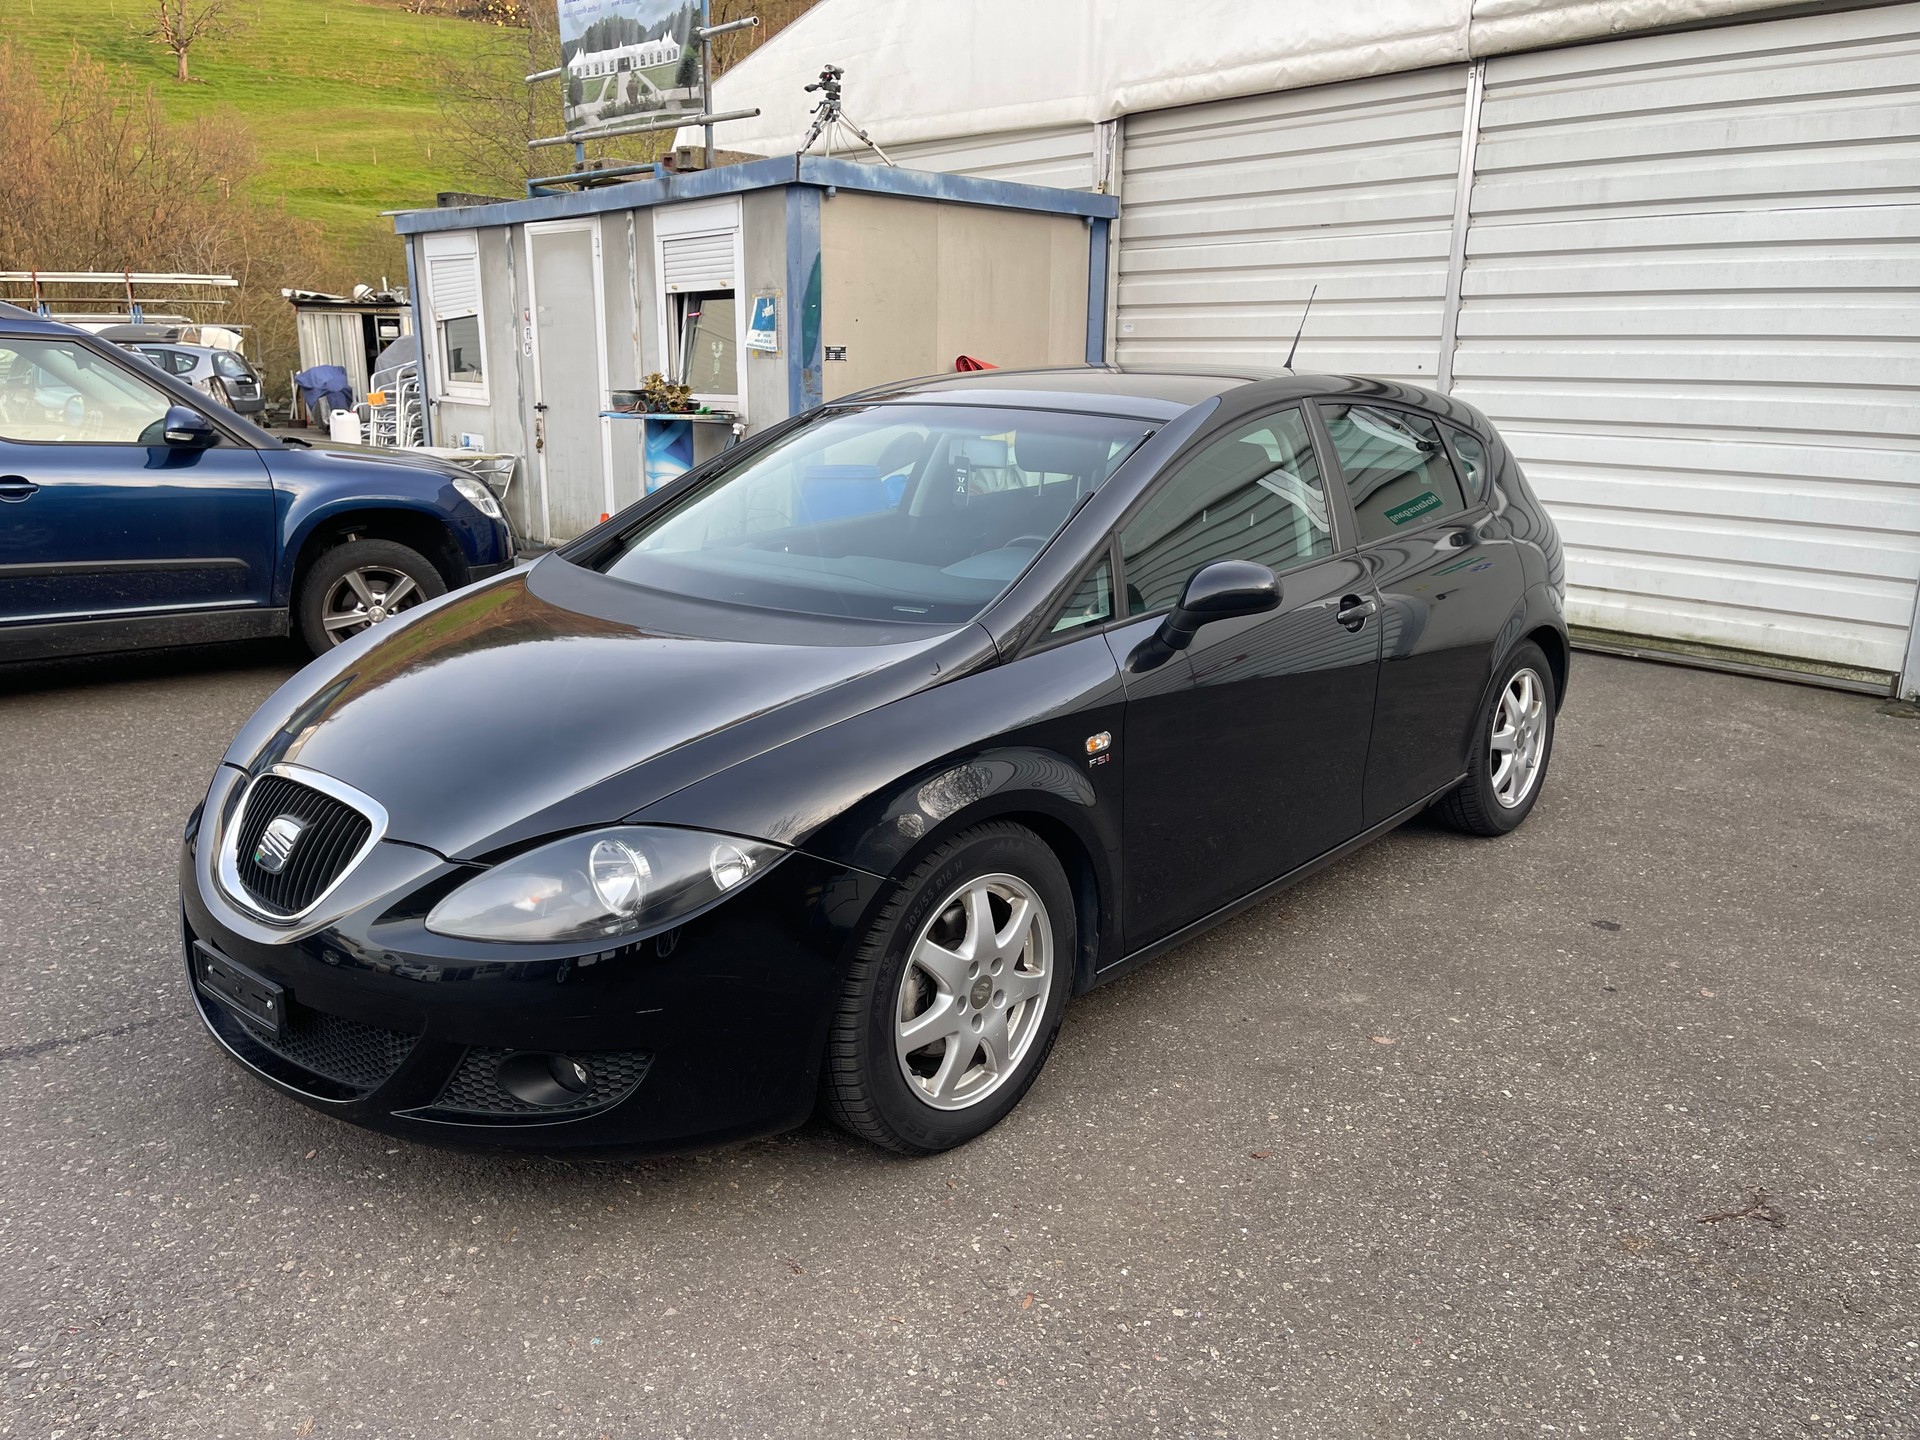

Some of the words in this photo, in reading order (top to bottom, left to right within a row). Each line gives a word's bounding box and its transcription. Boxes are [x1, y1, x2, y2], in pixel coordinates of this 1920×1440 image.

[905, 888, 935, 934] 205/55
[935, 869, 953, 890] R16
[954, 859, 964, 872] H
